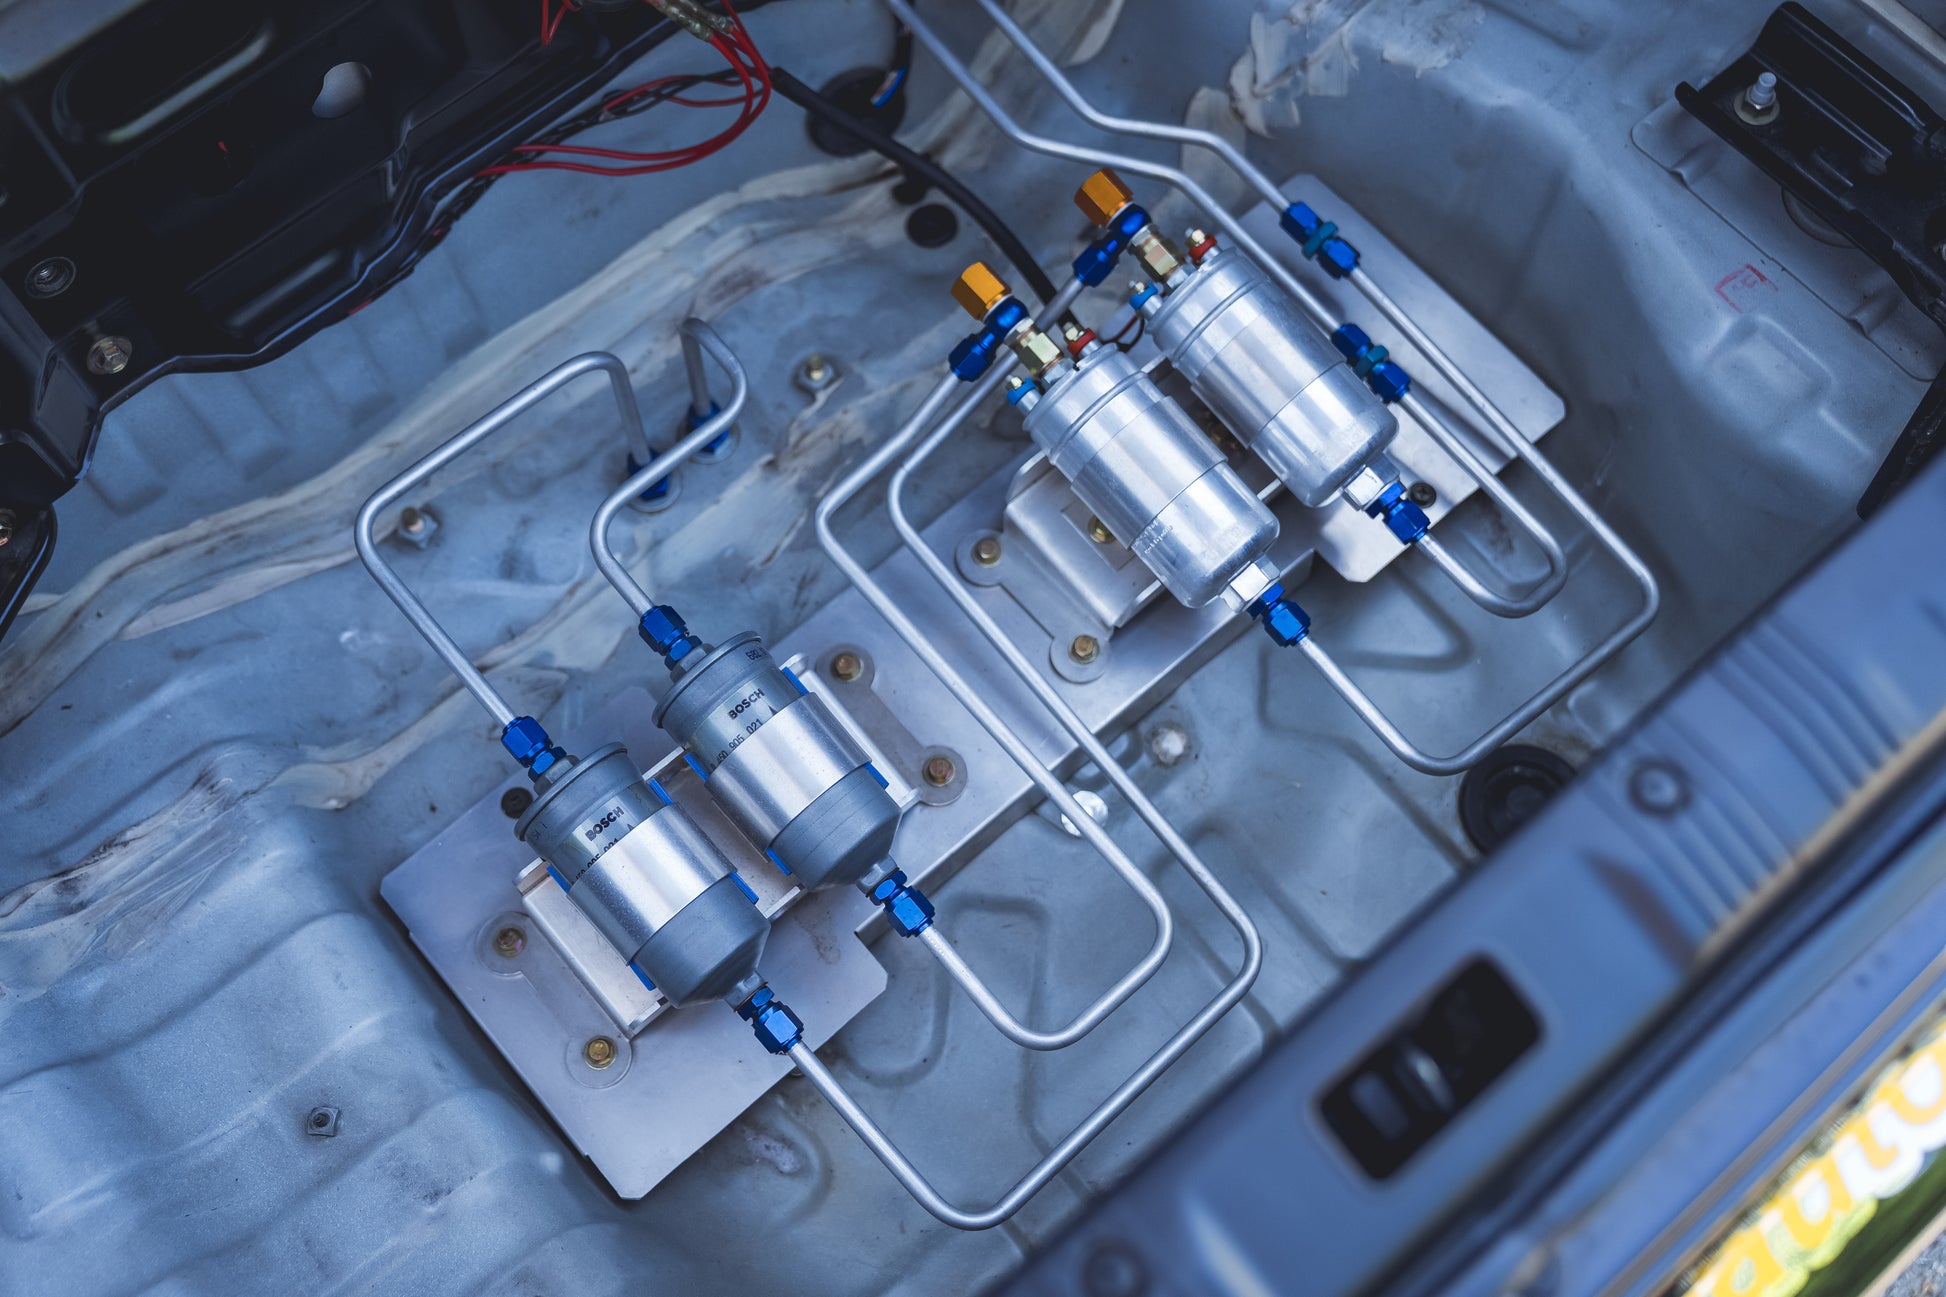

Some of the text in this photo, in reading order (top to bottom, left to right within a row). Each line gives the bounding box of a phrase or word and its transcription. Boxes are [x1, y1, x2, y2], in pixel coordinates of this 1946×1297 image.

[728, 688, 765, 720] BOSCH
[729, 734, 745, 751] 905
[746, 718, 764, 735] 021
[585, 807, 624, 841] BOSCH
